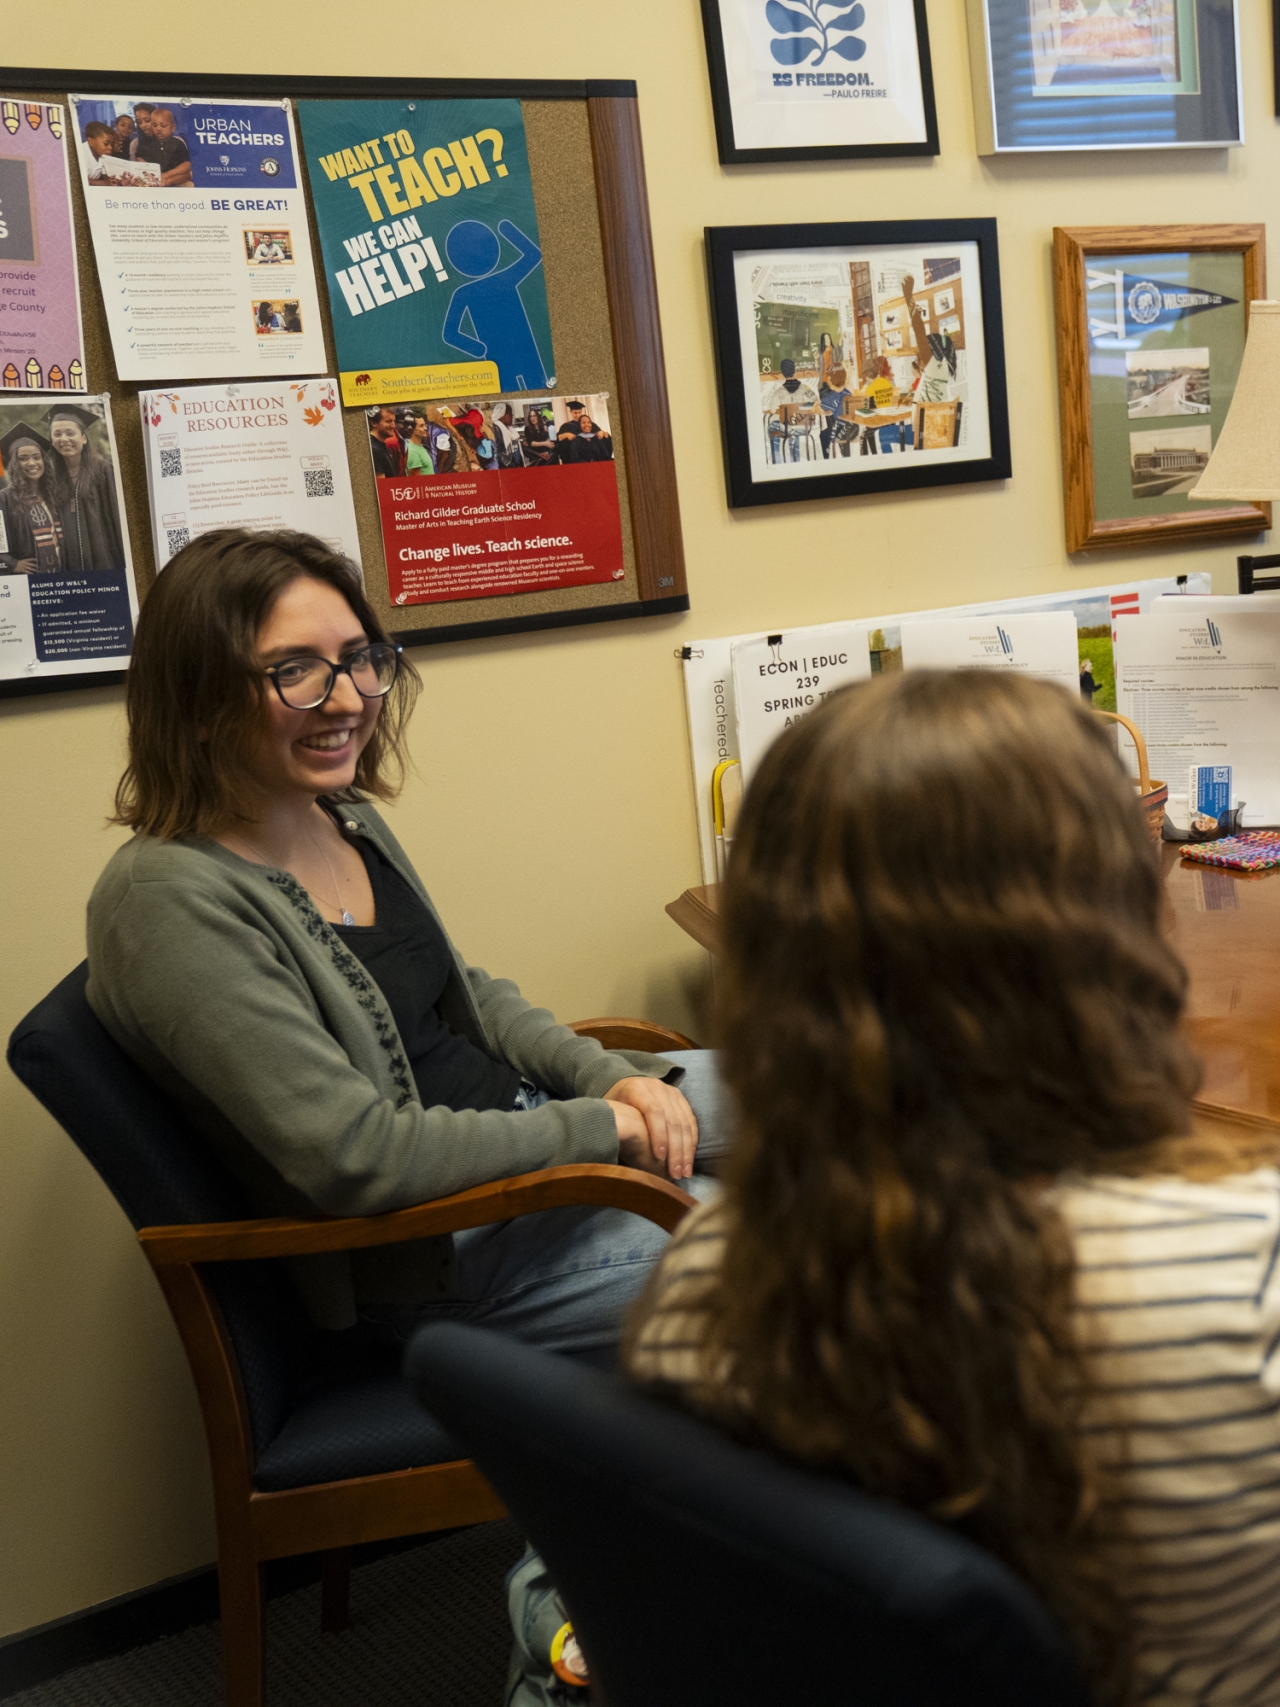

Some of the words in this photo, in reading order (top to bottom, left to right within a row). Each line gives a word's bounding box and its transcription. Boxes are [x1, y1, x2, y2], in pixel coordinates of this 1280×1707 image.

[772, 73, 793, 86] IS
[796, 73, 874, 86] FREEDOM.
[861, 89, 887, 98] FREIRE
[194, 118, 251, 131] URBAN
[196, 132, 284, 146] TEACHERS
[319, 139, 385, 182] WANT
[383, 128, 416, 160] TO
[348, 128, 509, 223] TEACH?
[105, 200, 119, 209] Be
[122, 201, 148, 209] more
[151, 200, 175, 210] than
[179, 200, 207, 212] good.
[211, 200, 230, 211] BE
[234, 200, 288, 211] GREAT!
[343, 230, 381, 263] WE
[378, 214, 423, 250] CAN
[335, 237, 449, 317] HELP!
[2, 286, 36, 297] recruit
[777, 294, 807, 304] creativity
[1163, 293, 1209, 310] WASHINGTON
[9, 302, 46, 314] County
[381, 371, 493, 389] SouthernTeachers.com
[382, 388, 399, 396] Great
[399, 387, 411, 395] jobs
[417, 386, 430, 394] great
[469, 382, 478, 390] the
[183, 397, 285, 416] EDUCATION
[187, 414, 288, 433] RESOURCES
[430, 490, 455, 498] NATURAL
[395, 509, 430, 522] Richard
[432, 507, 460, 519] Gilder
[462, 504, 505, 516] Graduate
[505, 500, 536, 512] School
[447, 518, 474, 526] Teaching
[399, 547, 450, 562] Change
[452, 543, 485, 556] lives.
[485, 538, 522, 553] Teach
[524, 535, 573, 549] science.
[439, 565, 450, 573] paid
[658, 576, 674, 587] 3M
[759, 660, 798, 677] ECON
[812, 653, 848, 669] EDUC
[796, 676, 820, 690] 239
[764, 695, 815, 713] SPRING
